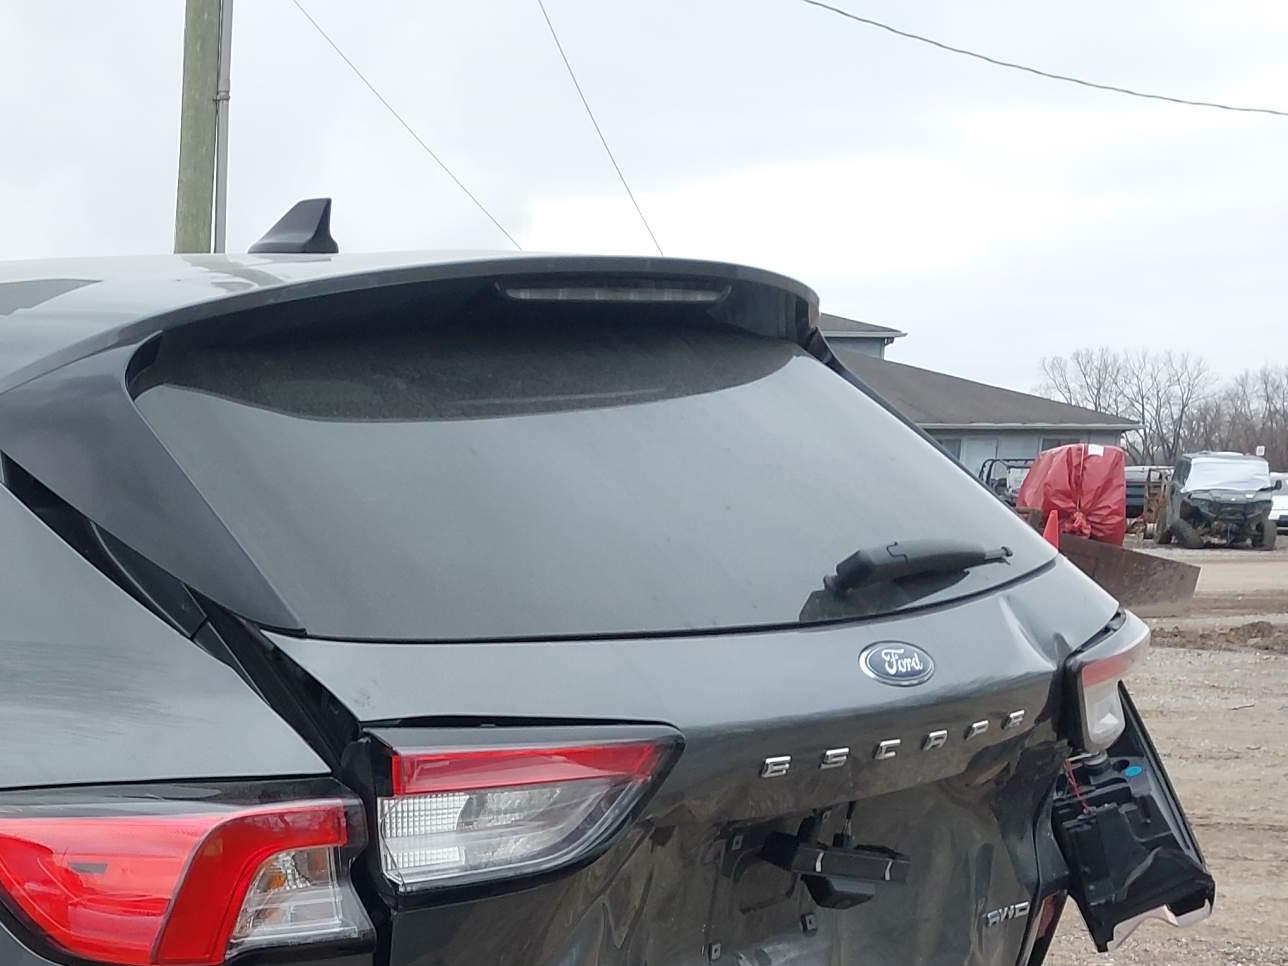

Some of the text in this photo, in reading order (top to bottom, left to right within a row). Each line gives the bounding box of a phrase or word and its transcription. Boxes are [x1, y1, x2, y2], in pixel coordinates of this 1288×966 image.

[881, 648, 924, 675] Ford
[761, 709, 1025, 778] ESCAPE
[986, 901, 1030, 928] AWD
